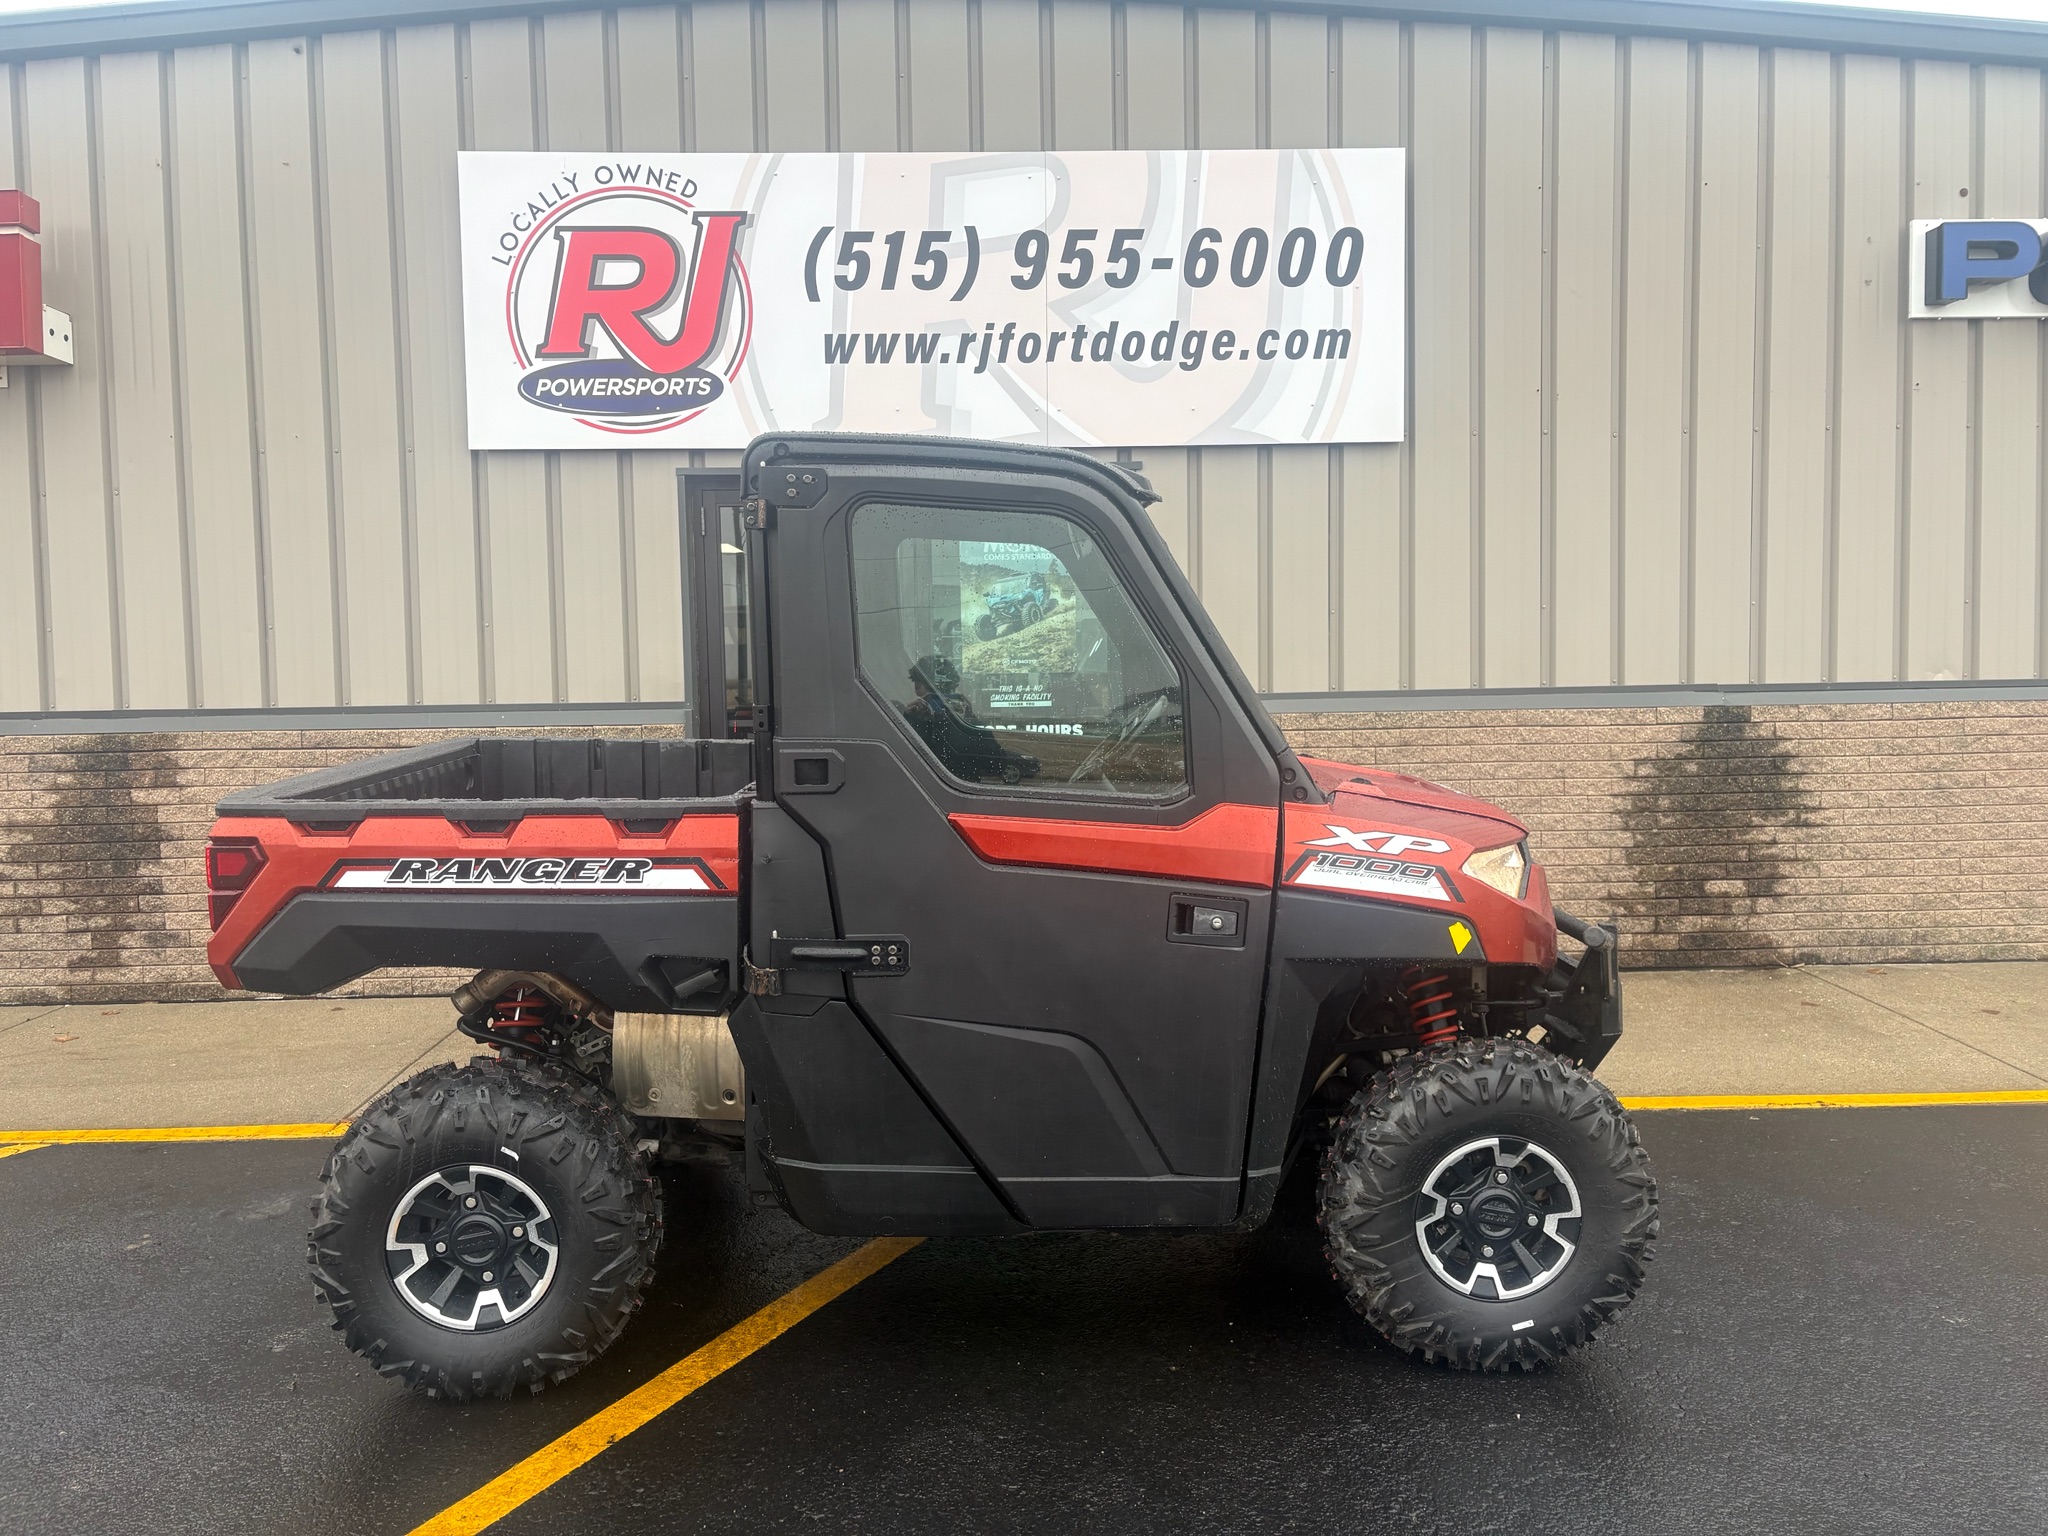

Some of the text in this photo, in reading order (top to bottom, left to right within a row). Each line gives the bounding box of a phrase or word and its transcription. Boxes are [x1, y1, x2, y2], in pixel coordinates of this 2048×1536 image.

[491, 163, 698, 267] LOCALLY OWNED
[804, 226, 1365, 302] (515) 955-6000
[1925, 221, 2048, 306] P
[534, 210, 756, 375] RJ
[823, 320, 1352, 374] www.rjfortdodge.com
[535, 377, 712, 397] POWERSPORTS
[984, 552, 1052, 561] COMES STANDARD
[990, 692, 1052, 702] SMOKING FACILITY
[999, 685, 1013, 693] THIS
[1025, 724, 1083, 736] HOURS
[1295, 824, 1453, 855] XP
[386, 858, 653, 884] RANGER
[1313, 852, 1436, 881] 1000
